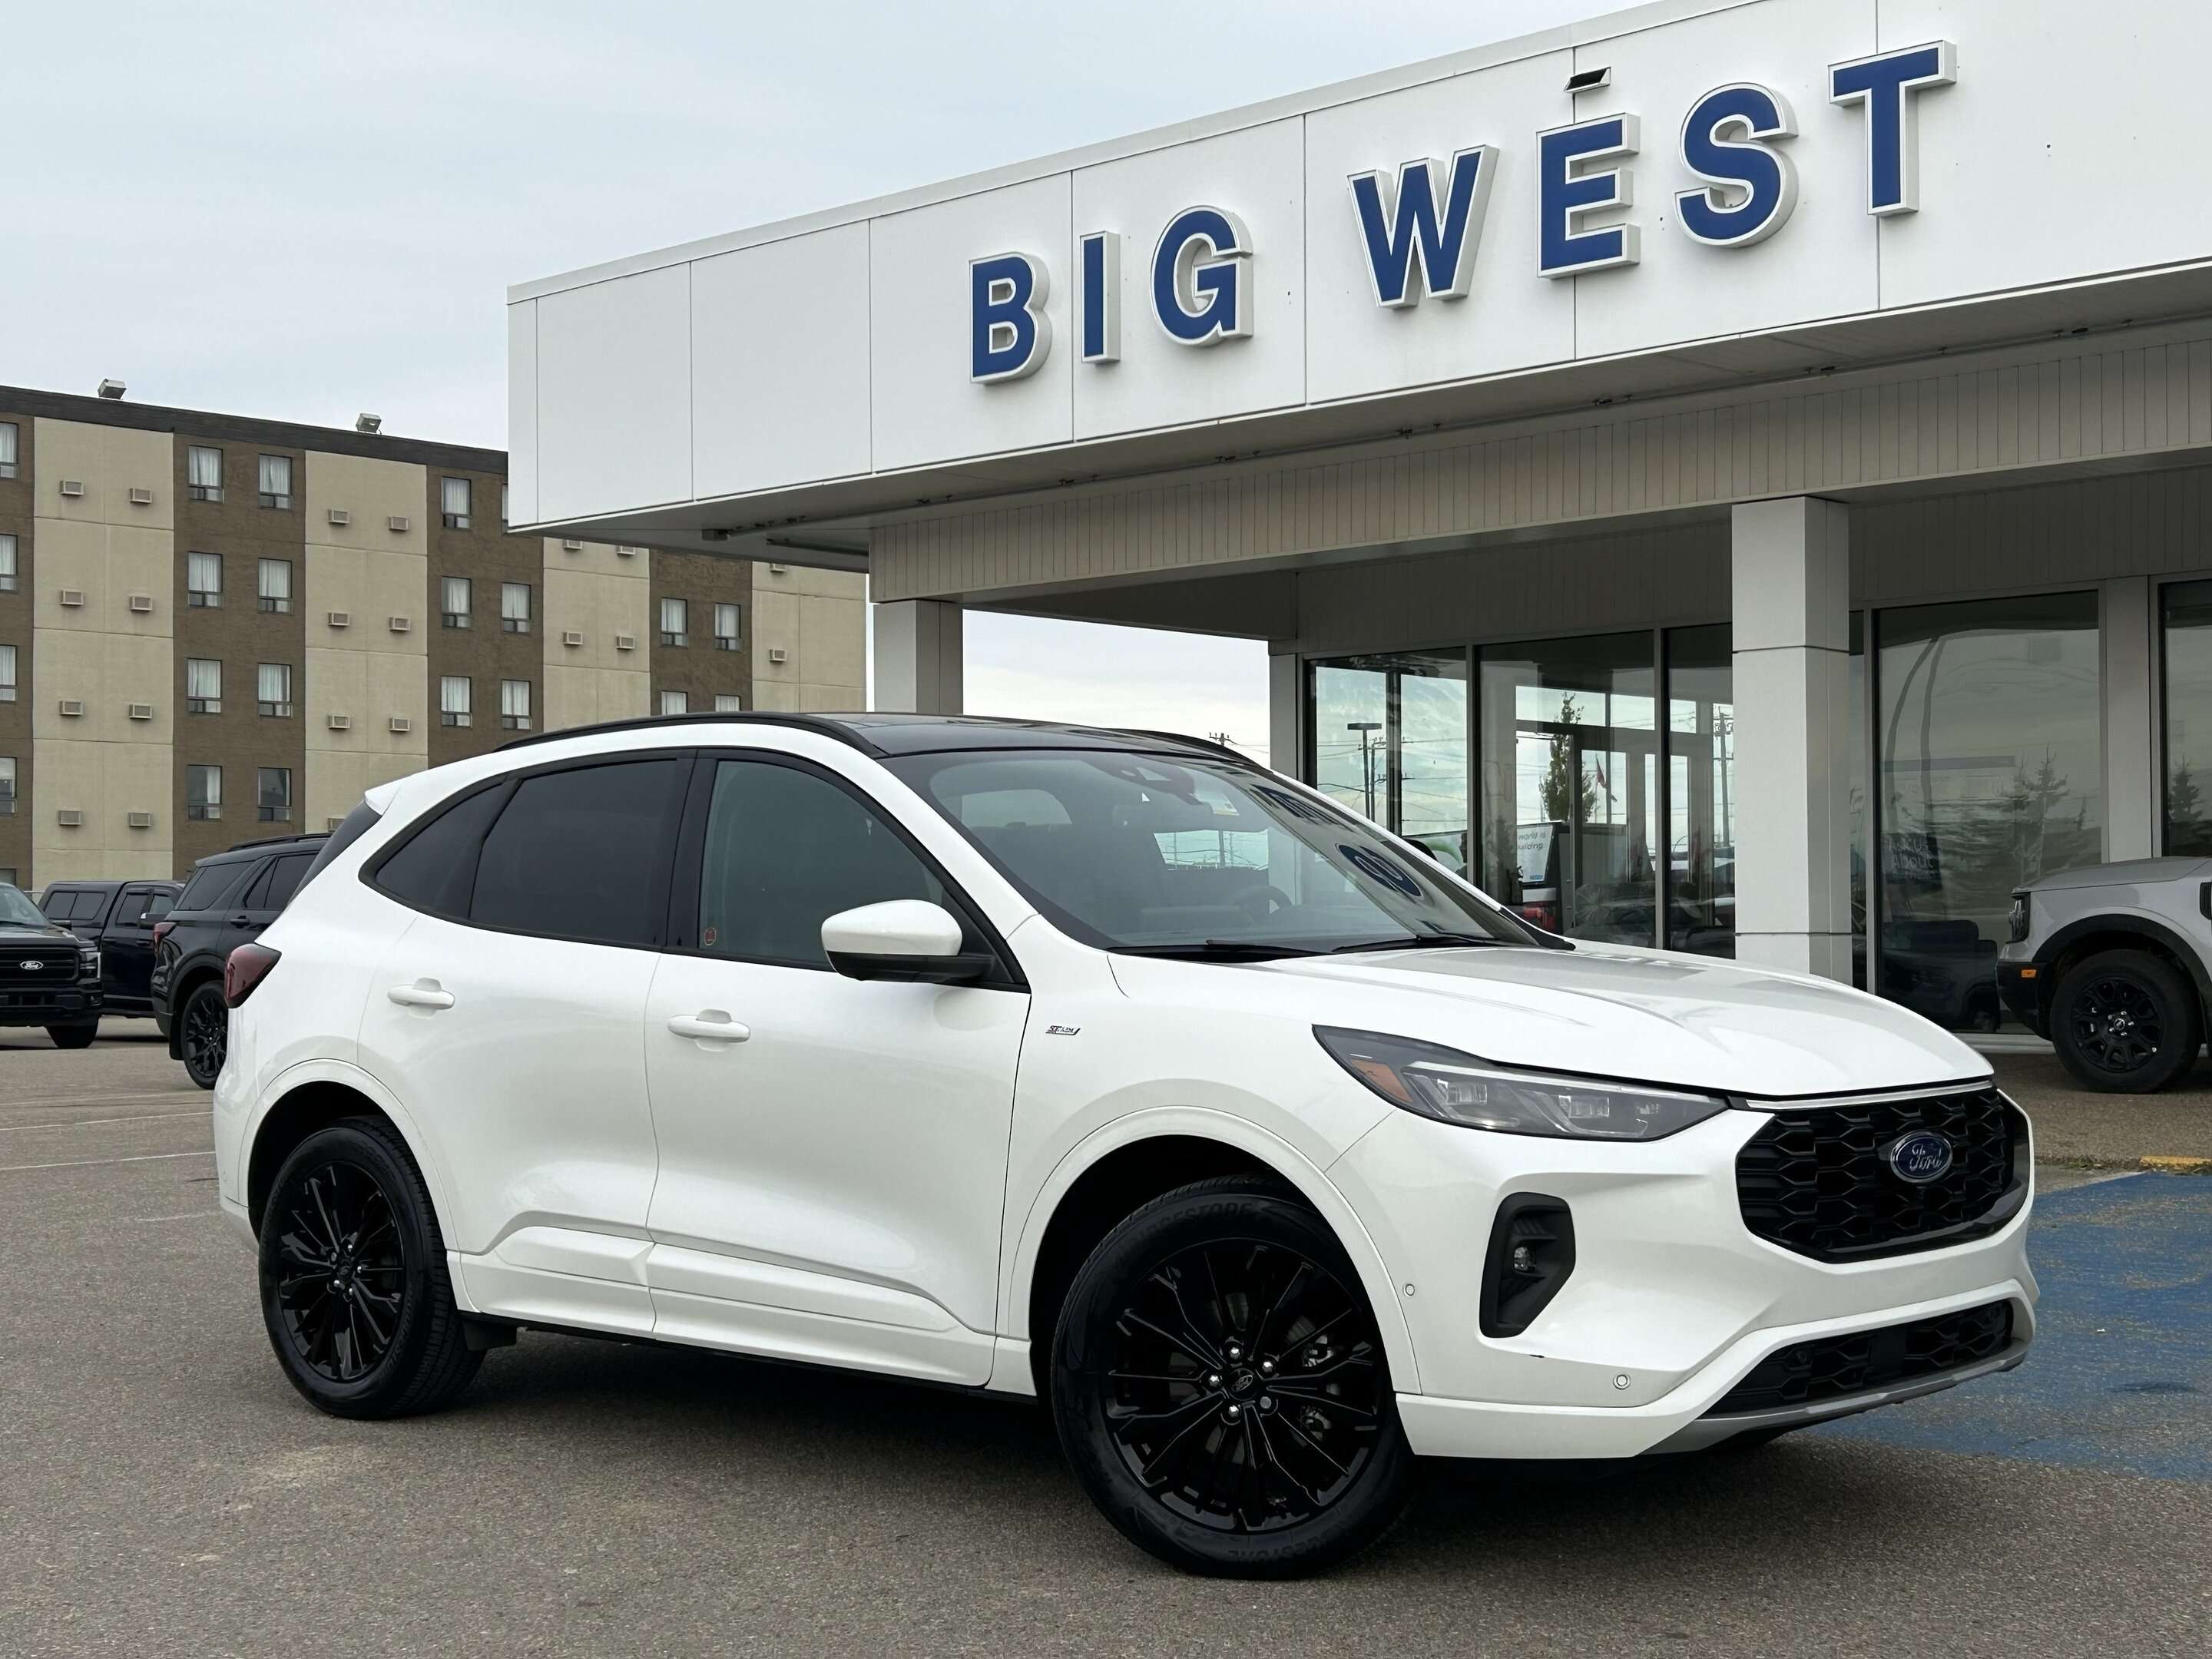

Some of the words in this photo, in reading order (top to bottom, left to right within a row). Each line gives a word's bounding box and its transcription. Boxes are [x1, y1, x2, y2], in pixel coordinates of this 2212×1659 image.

[969, 204, 1253, 384] BIG
[1347, 39, 1957, 308] WEST
[1517, 842, 1544, 852] uilding
[1909, 1143, 1943, 1172] Ford
